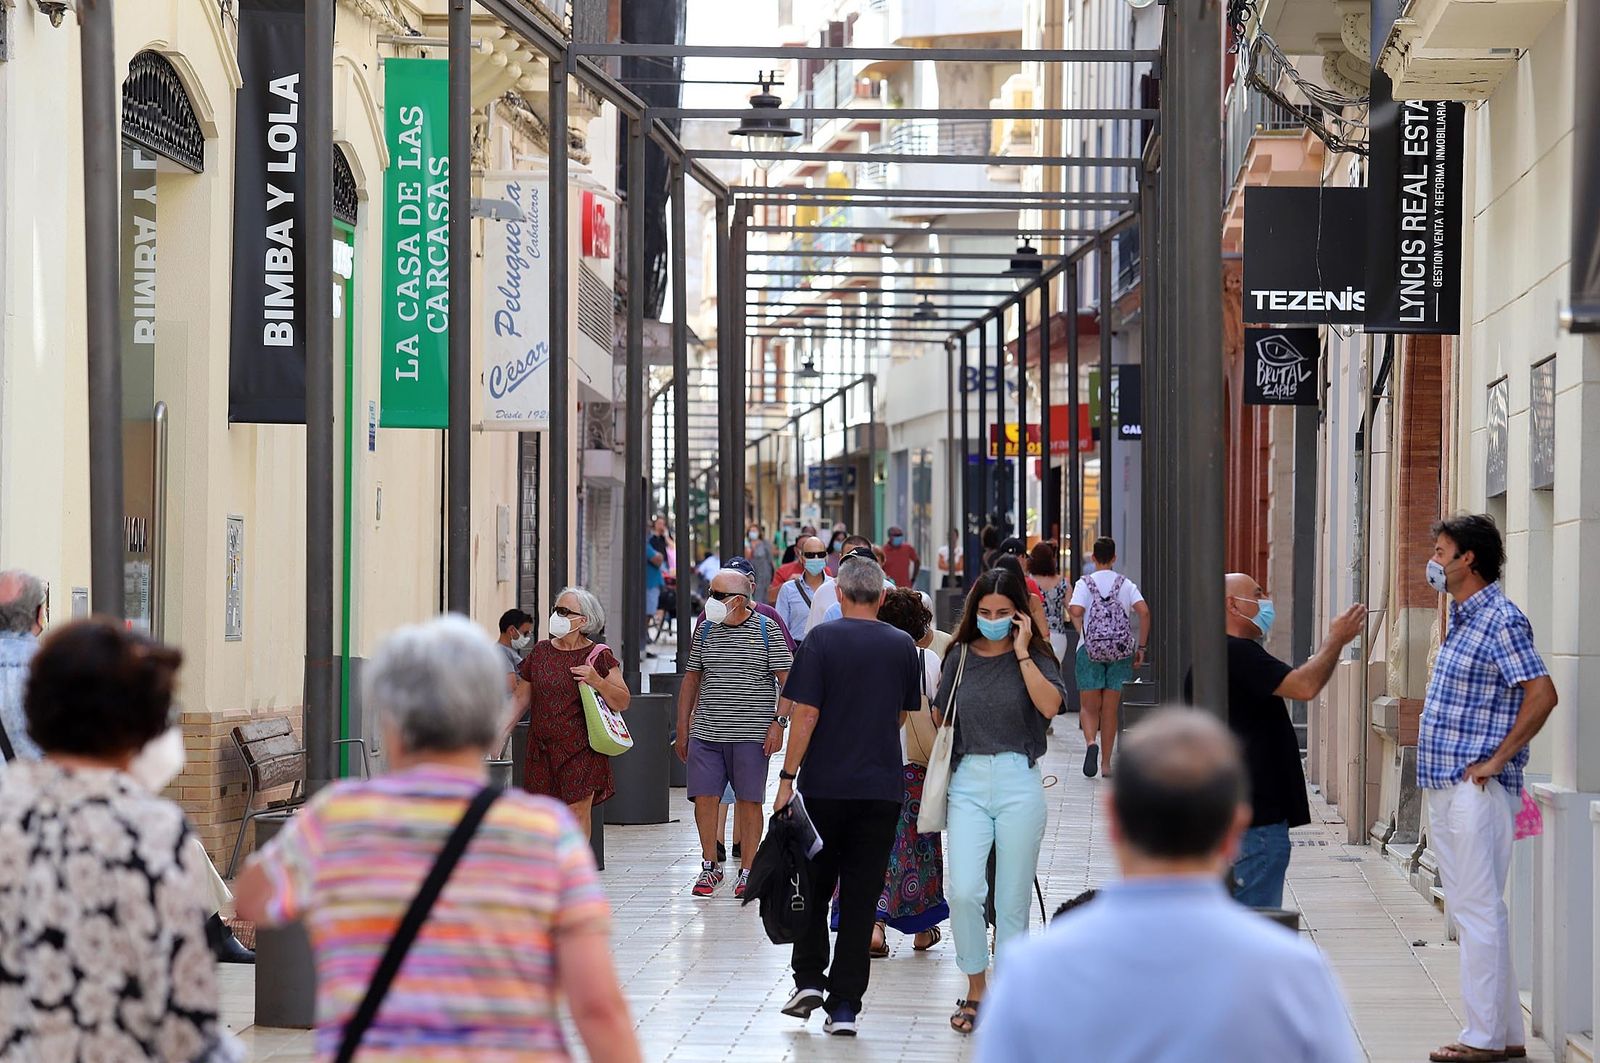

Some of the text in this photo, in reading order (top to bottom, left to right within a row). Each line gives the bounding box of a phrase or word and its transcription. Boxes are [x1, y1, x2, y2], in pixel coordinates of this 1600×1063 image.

[263, 73, 300, 347] BIMBA Y LOLA
[395, 105, 424, 382] LA CASA DE LAS
[426, 156, 449, 334] CARCASAS
[526, 188, 541, 259] Caballeros
[1400, 99, 1429, 322] LYNCIS REAL ESTA
[1432, 100, 1447, 287] GESTION VENTA Y REFORMA INMOBILIARIA
[527, 410, 549, 419] 192
[1121, 424, 1142, 435] CAL
[1256, 358, 1312, 387] BRUTAL
